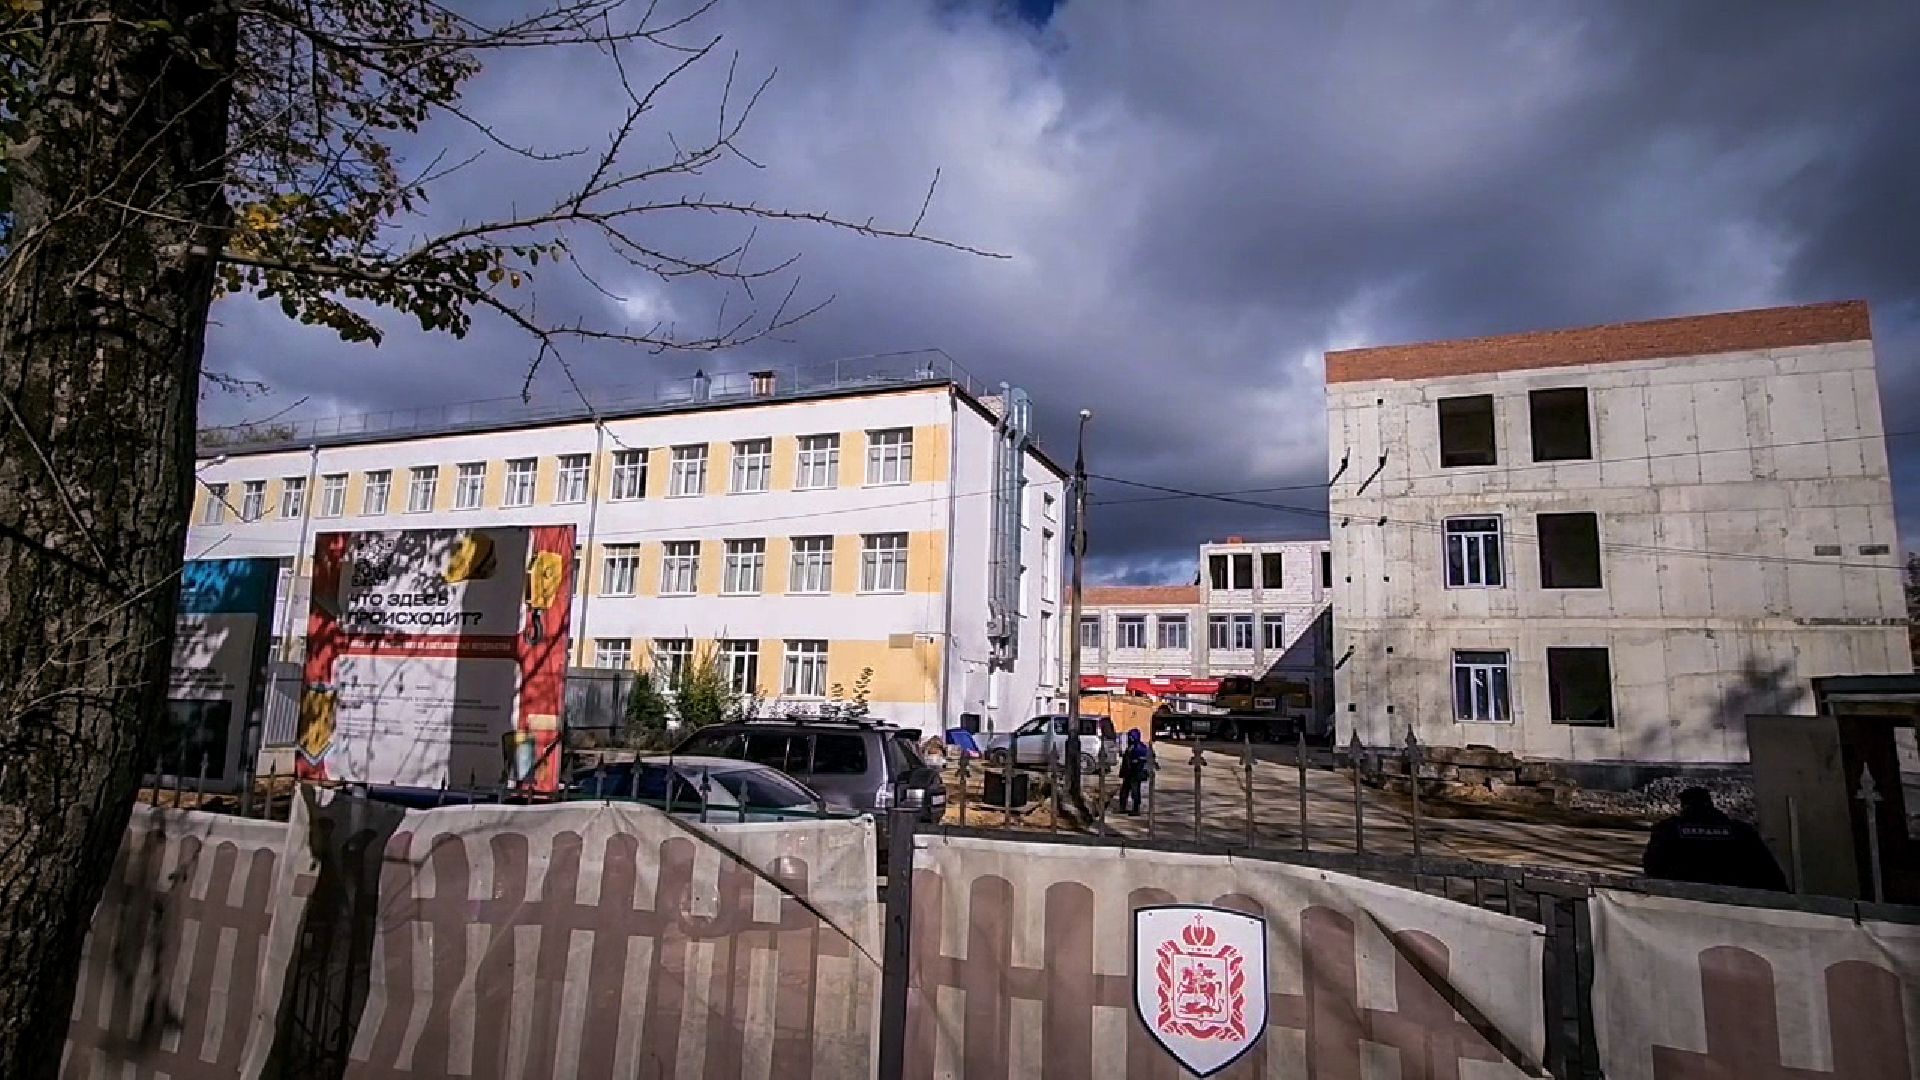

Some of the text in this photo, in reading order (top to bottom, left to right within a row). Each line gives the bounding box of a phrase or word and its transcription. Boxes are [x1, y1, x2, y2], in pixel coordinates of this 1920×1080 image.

[349, 593, 449, 607] ЧТО ЗДЕСЬ
[347, 611, 484, 627] ПРОИСХОДИТ?
[1682, 827, 1729, 836] ОХРАНА
